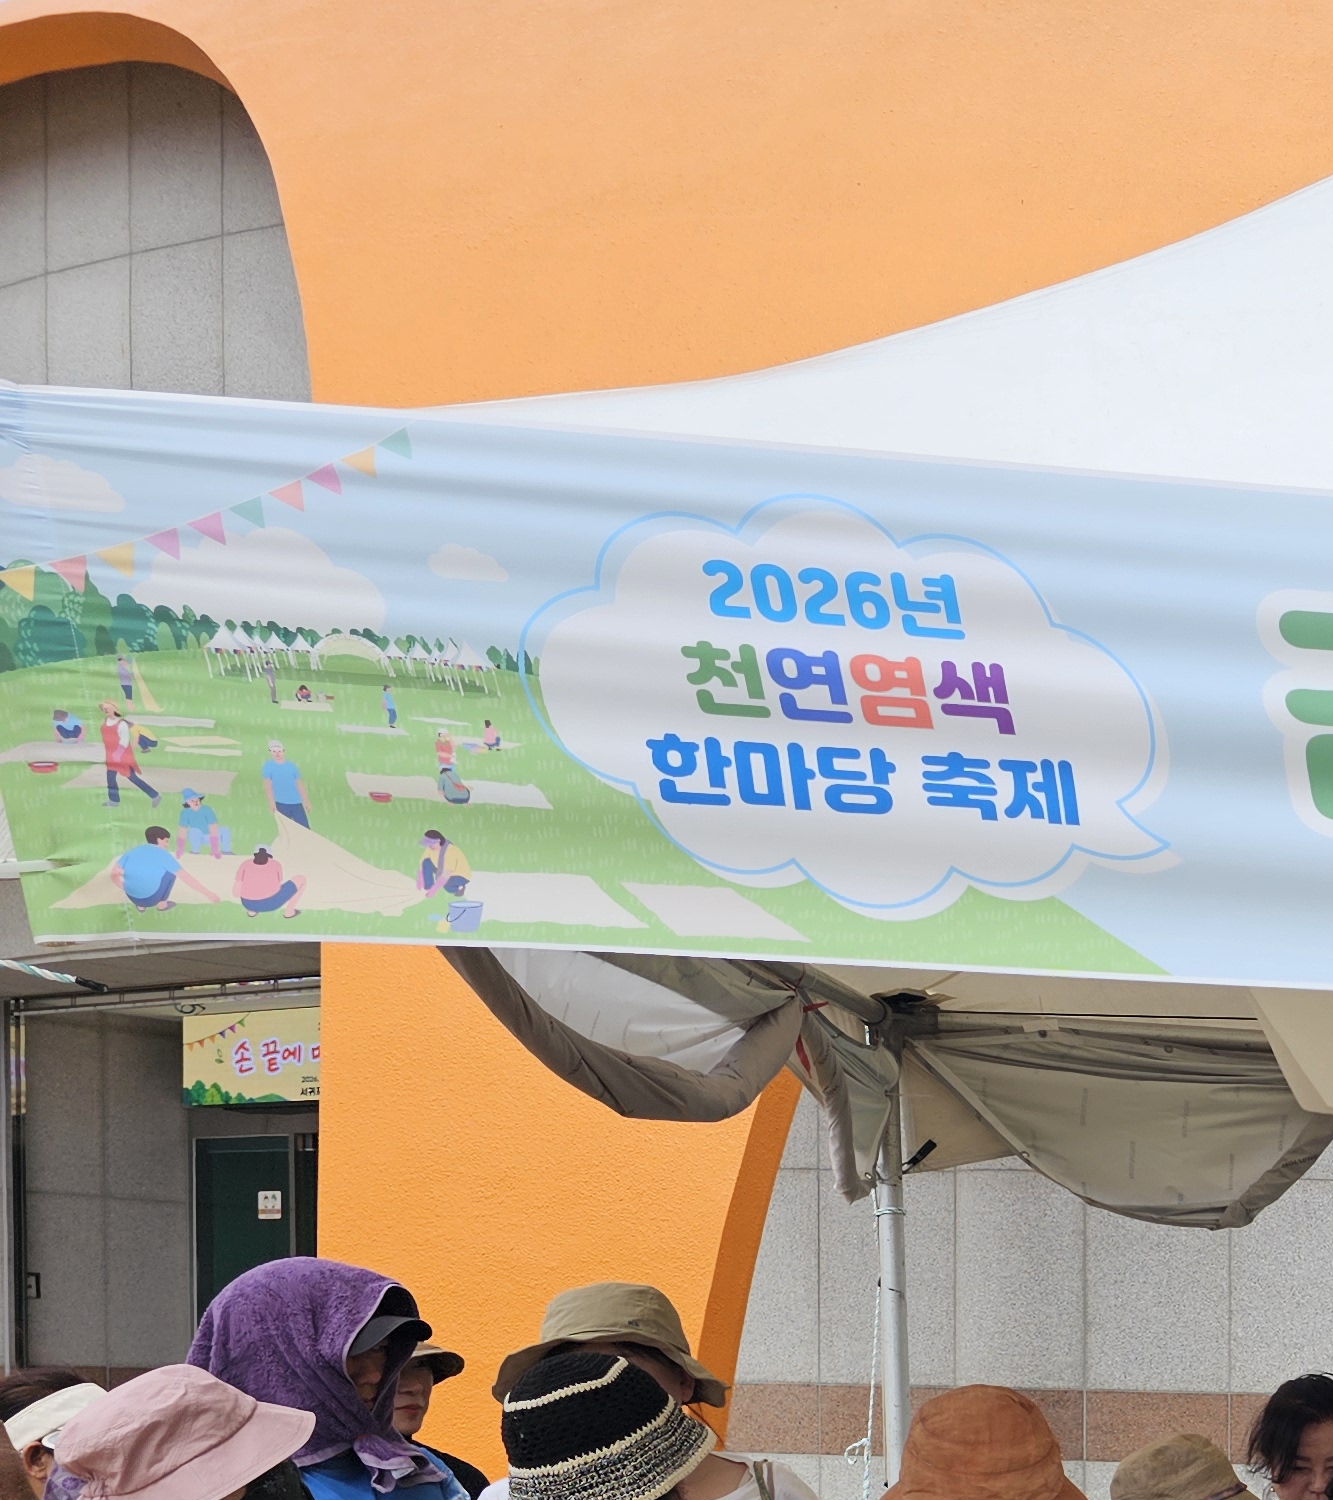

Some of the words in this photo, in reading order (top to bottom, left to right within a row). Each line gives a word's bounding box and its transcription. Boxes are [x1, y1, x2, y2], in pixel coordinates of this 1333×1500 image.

[701, 558, 966, 640] 2026년
[680, 639, 1016, 736] 천연염색
[646, 732, 896, 816] 한마당
[920, 751, 1081, 827] 축제
[235, 1041, 253, 1074] 손
[262, 1040, 301, 1072] 끝에
